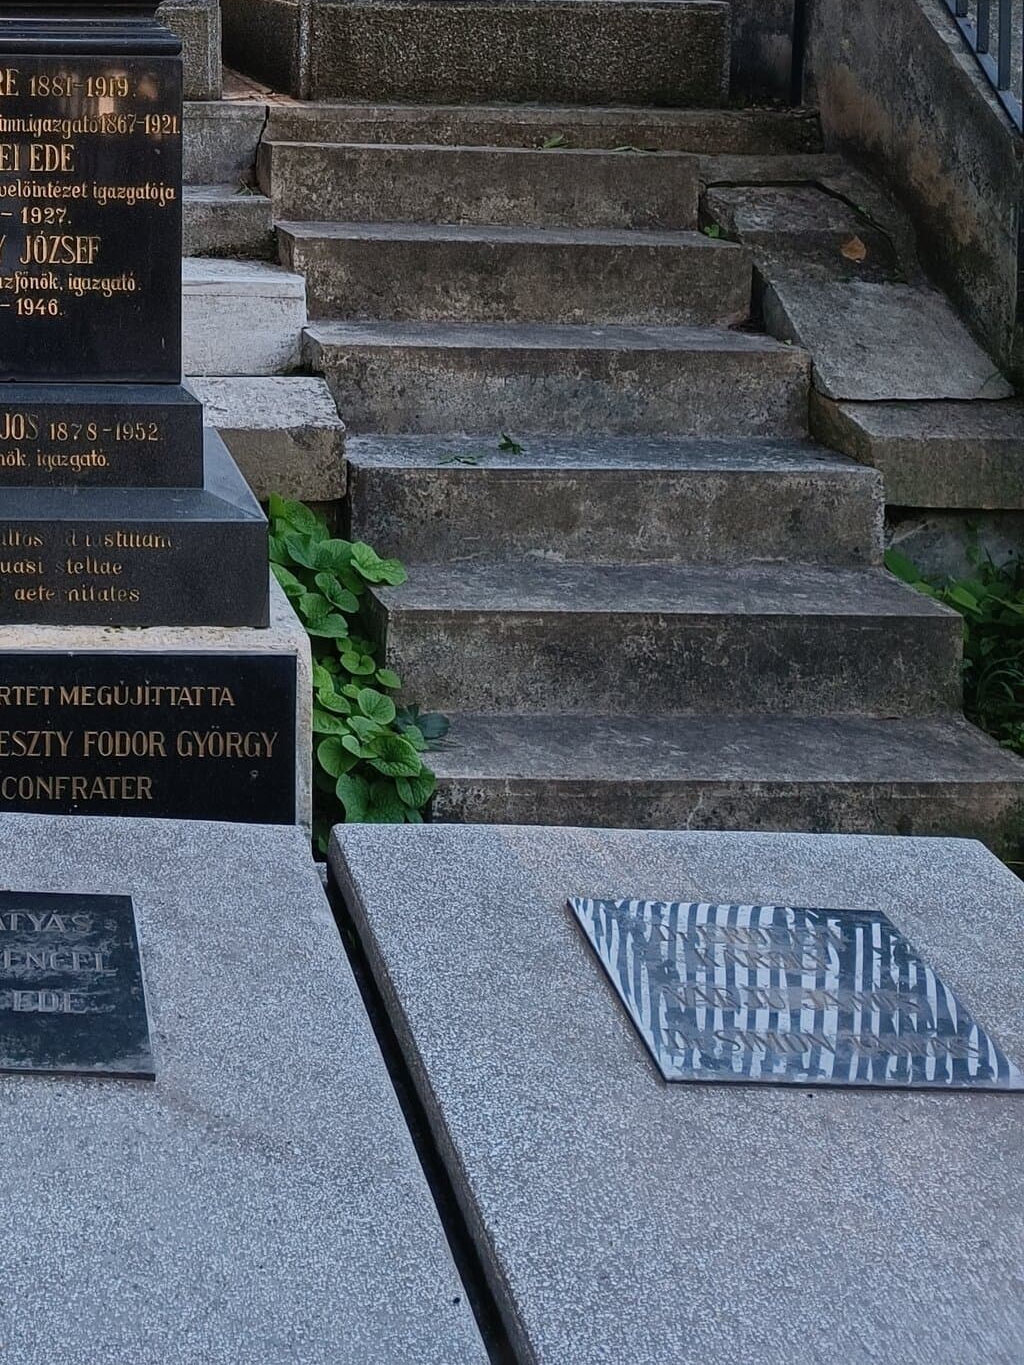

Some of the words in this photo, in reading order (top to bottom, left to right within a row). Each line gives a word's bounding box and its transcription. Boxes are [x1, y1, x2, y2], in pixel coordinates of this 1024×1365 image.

[29, 144, 76, 171] EDE
[92, 181, 177, 207] igazgatója
[21, 207, 72, 224] 1927.
[20, 231, 101, 264] JÓZSEF
[55, 555, 123, 575] stellae
[83, 731, 166, 758] FODOR
[177, 725, 278, 759] GYÖRGY
[1, 775, 153, 800] CONFRATER
[12, 988, 88, 1014] EDE
